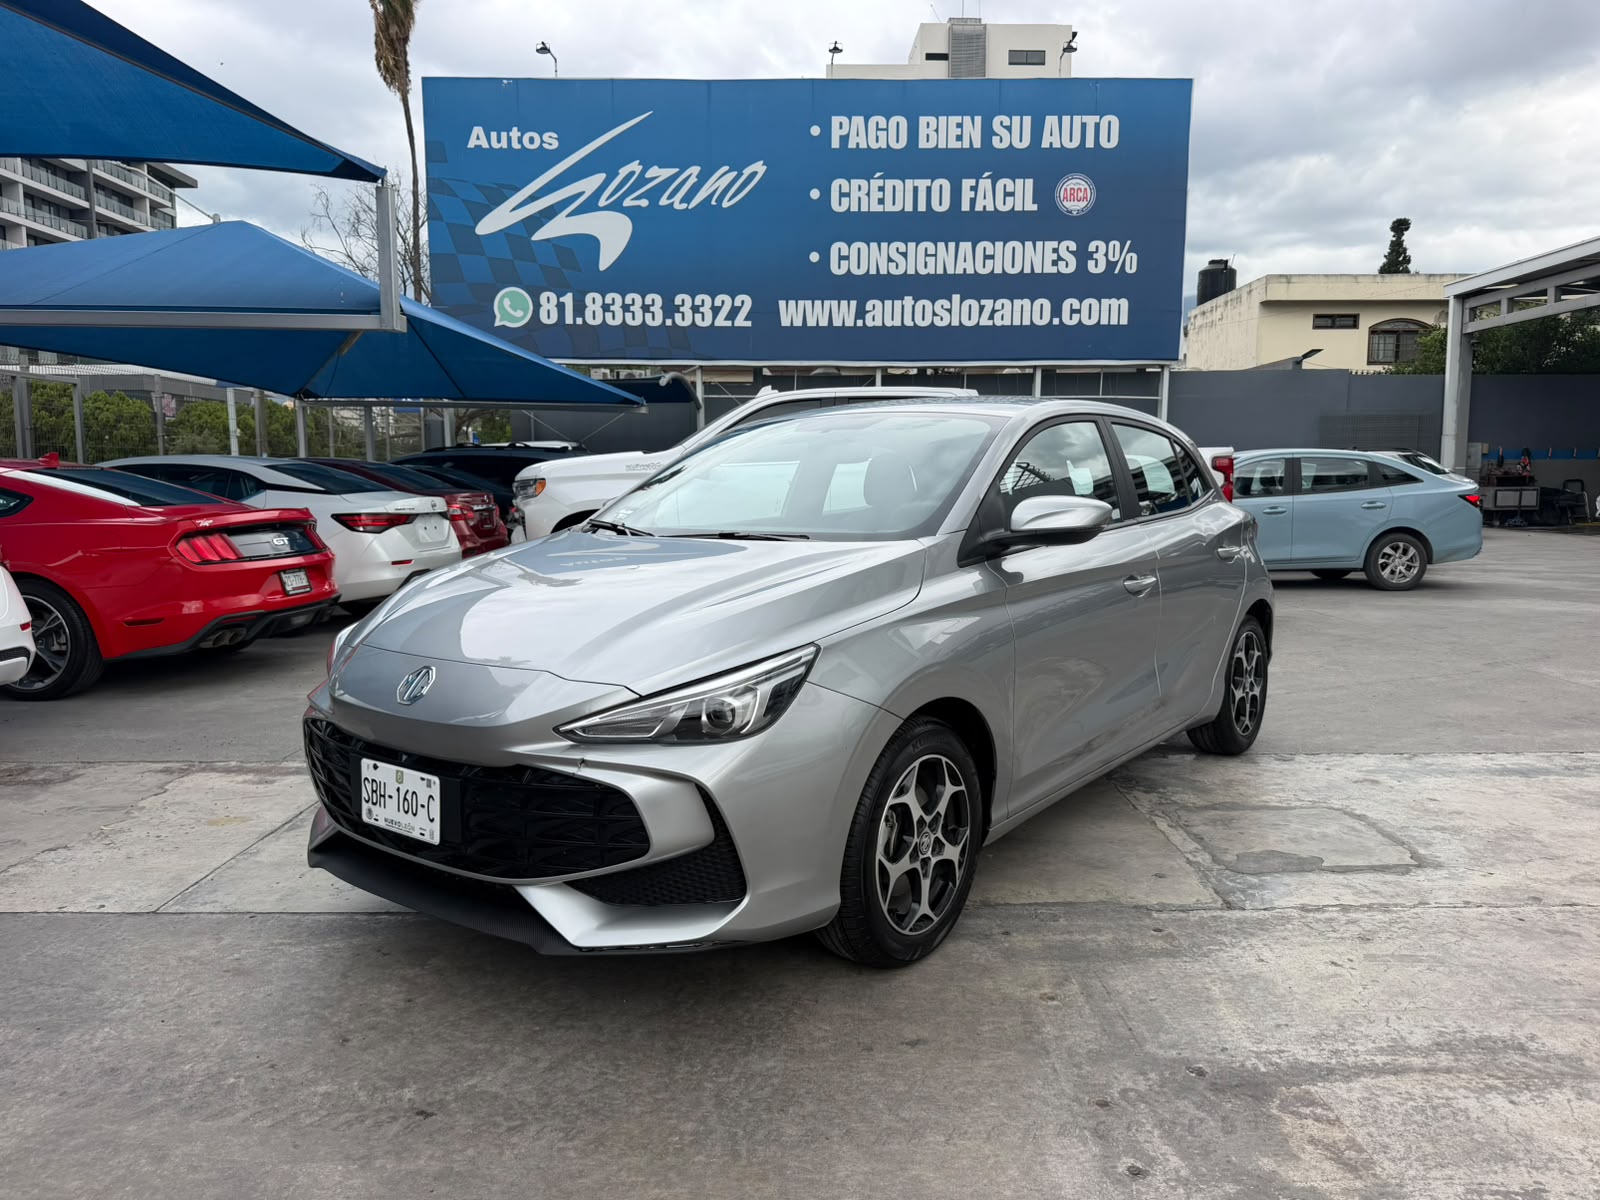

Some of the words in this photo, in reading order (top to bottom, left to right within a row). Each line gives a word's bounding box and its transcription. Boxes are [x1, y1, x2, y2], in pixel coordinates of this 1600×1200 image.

[467, 126, 559, 150] Autos
[831, 115, 908, 150] PAGO
[918, 115, 982, 149] BIEN
[991, 115, 1032, 149] SU
[1041, 114, 1120, 149] AUTO
[474, 110, 767, 271] Lozano
[830, 172, 951, 213] CRÉDITO
[960, 172, 1038, 212] FÁCIL
[1062, 186, 1089, 203] ARCA
[830, 240, 1077, 275] CONSIGNACIONES
[1087, 239, 1138, 275] 3%
[539, 291, 752, 328] 81.8333.3322
[778, 294, 1129, 328] www.autoslozano.com
[272, 536, 290, 546] GT
[397, 666, 436, 706] MG
[363, 776, 435, 823] SBH-160-C
